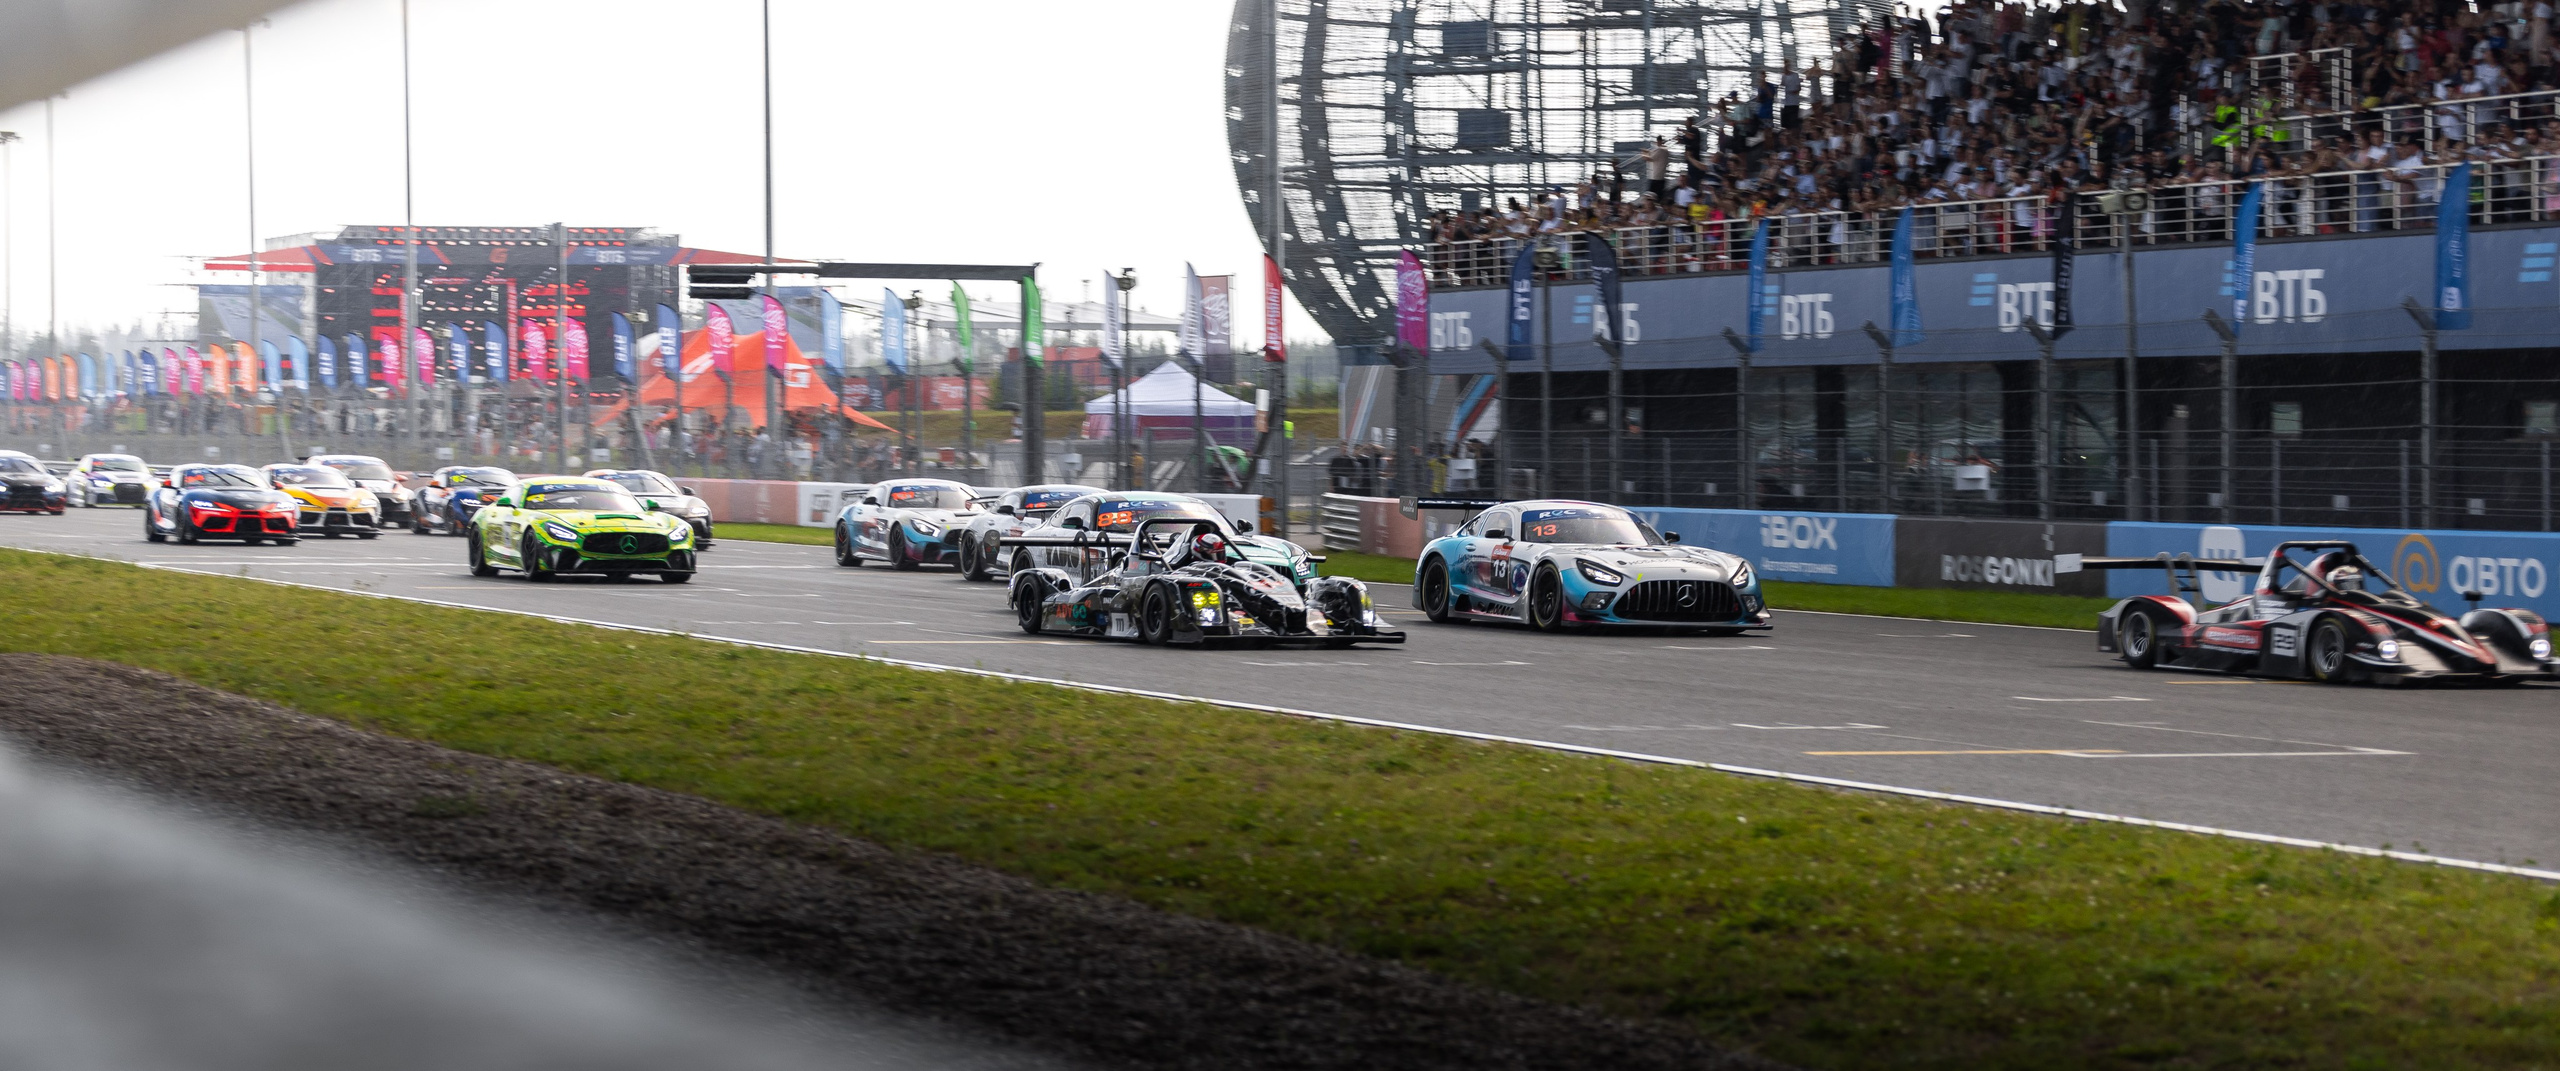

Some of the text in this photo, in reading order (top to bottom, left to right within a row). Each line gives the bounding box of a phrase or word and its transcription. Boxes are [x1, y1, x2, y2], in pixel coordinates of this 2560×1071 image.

[2253, 269, 2328, 324] ВТБ
[1430, 311, 1474, 351] ВТБ
[1593, 303, 1640, 346] ВБ
[1781, 293, 1835, 340] ВТБ
[1097, 510, 1133, 527] 88
[1532, 524, 1557, 537] 13
[1493, 559, 1507, 578] 13
[1941, 554, 2055, 587] ROSGONKI
